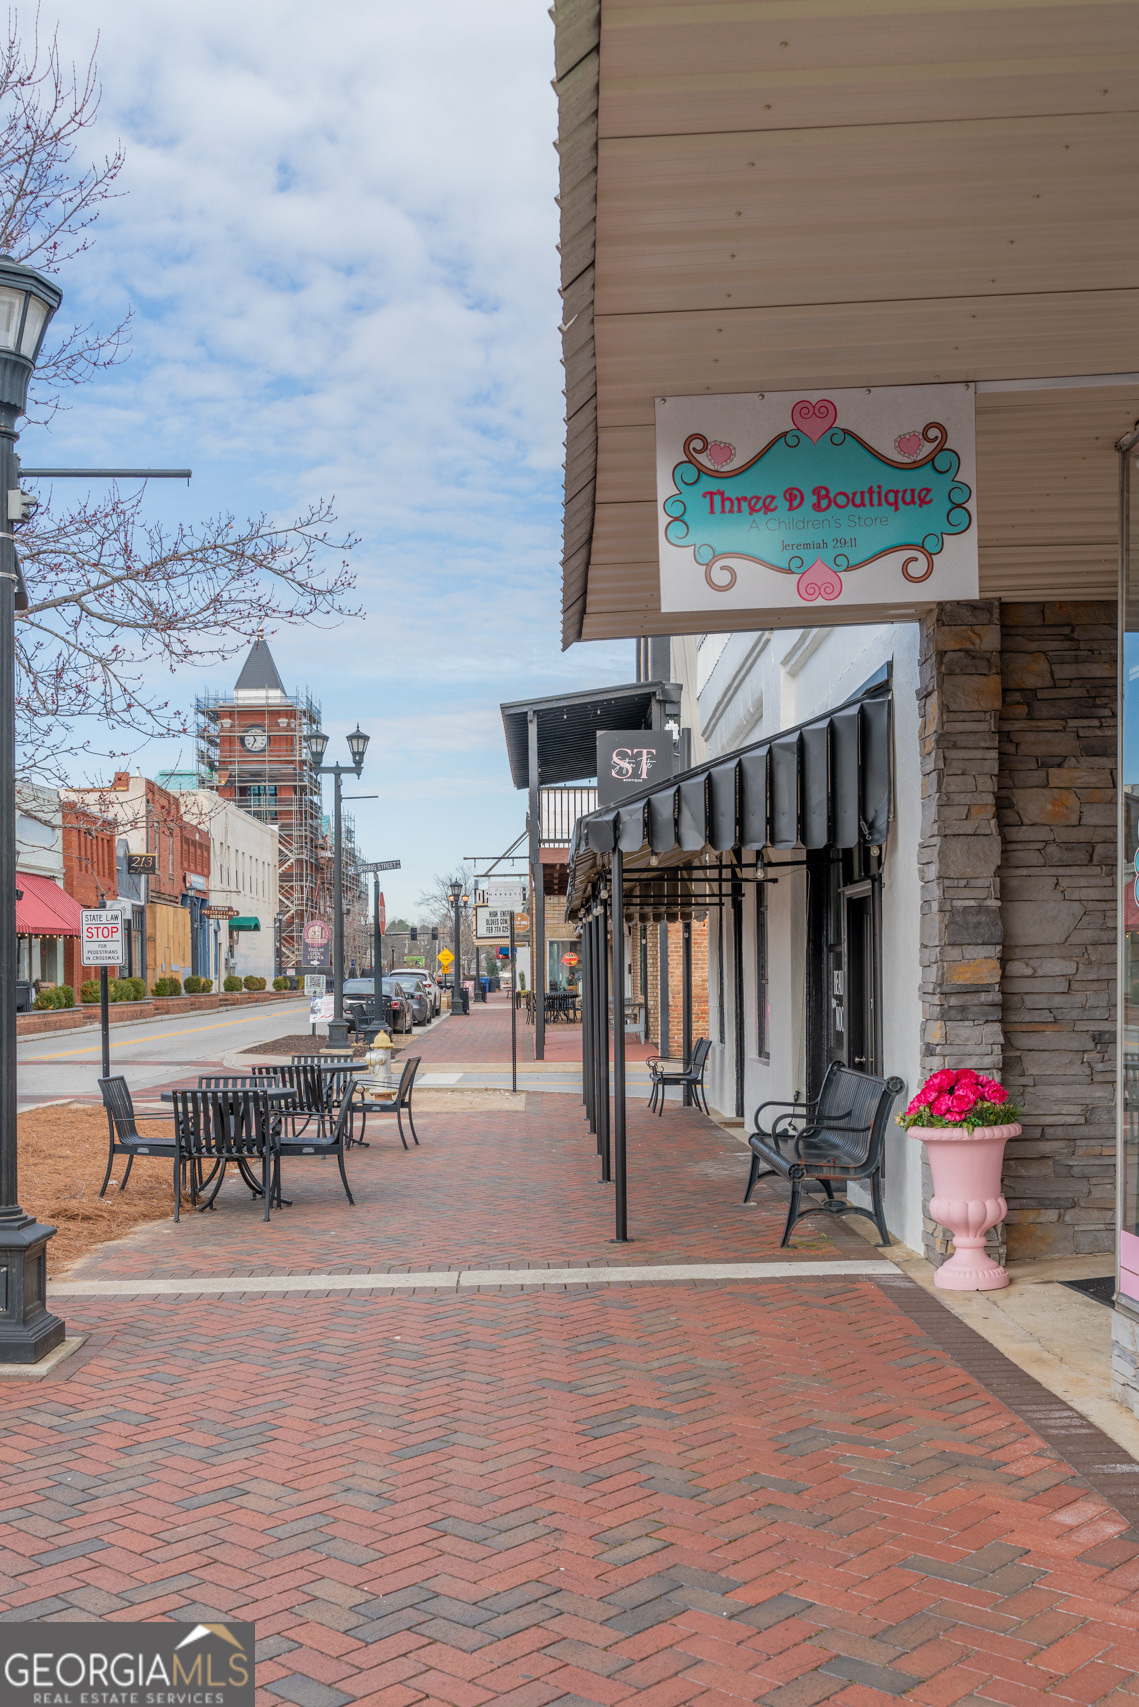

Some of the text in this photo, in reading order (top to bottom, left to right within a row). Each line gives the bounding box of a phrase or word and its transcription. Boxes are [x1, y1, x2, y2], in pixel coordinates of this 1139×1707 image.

[702, 484, 933, 516] Three D Boutique
[748, 514, 889, 532] A Children's Store
[781, 537, 857, 552] Jeremiah 29:11
[131, 856, 153, 868] 213
[351, 866, 356, 874] E
[357, 864, 377, 872] SPRING
[377, 861, 397, 870] STREET
[84, 913, 120, 922] STATE LAW
[86, 926, 119, 939] STOP
